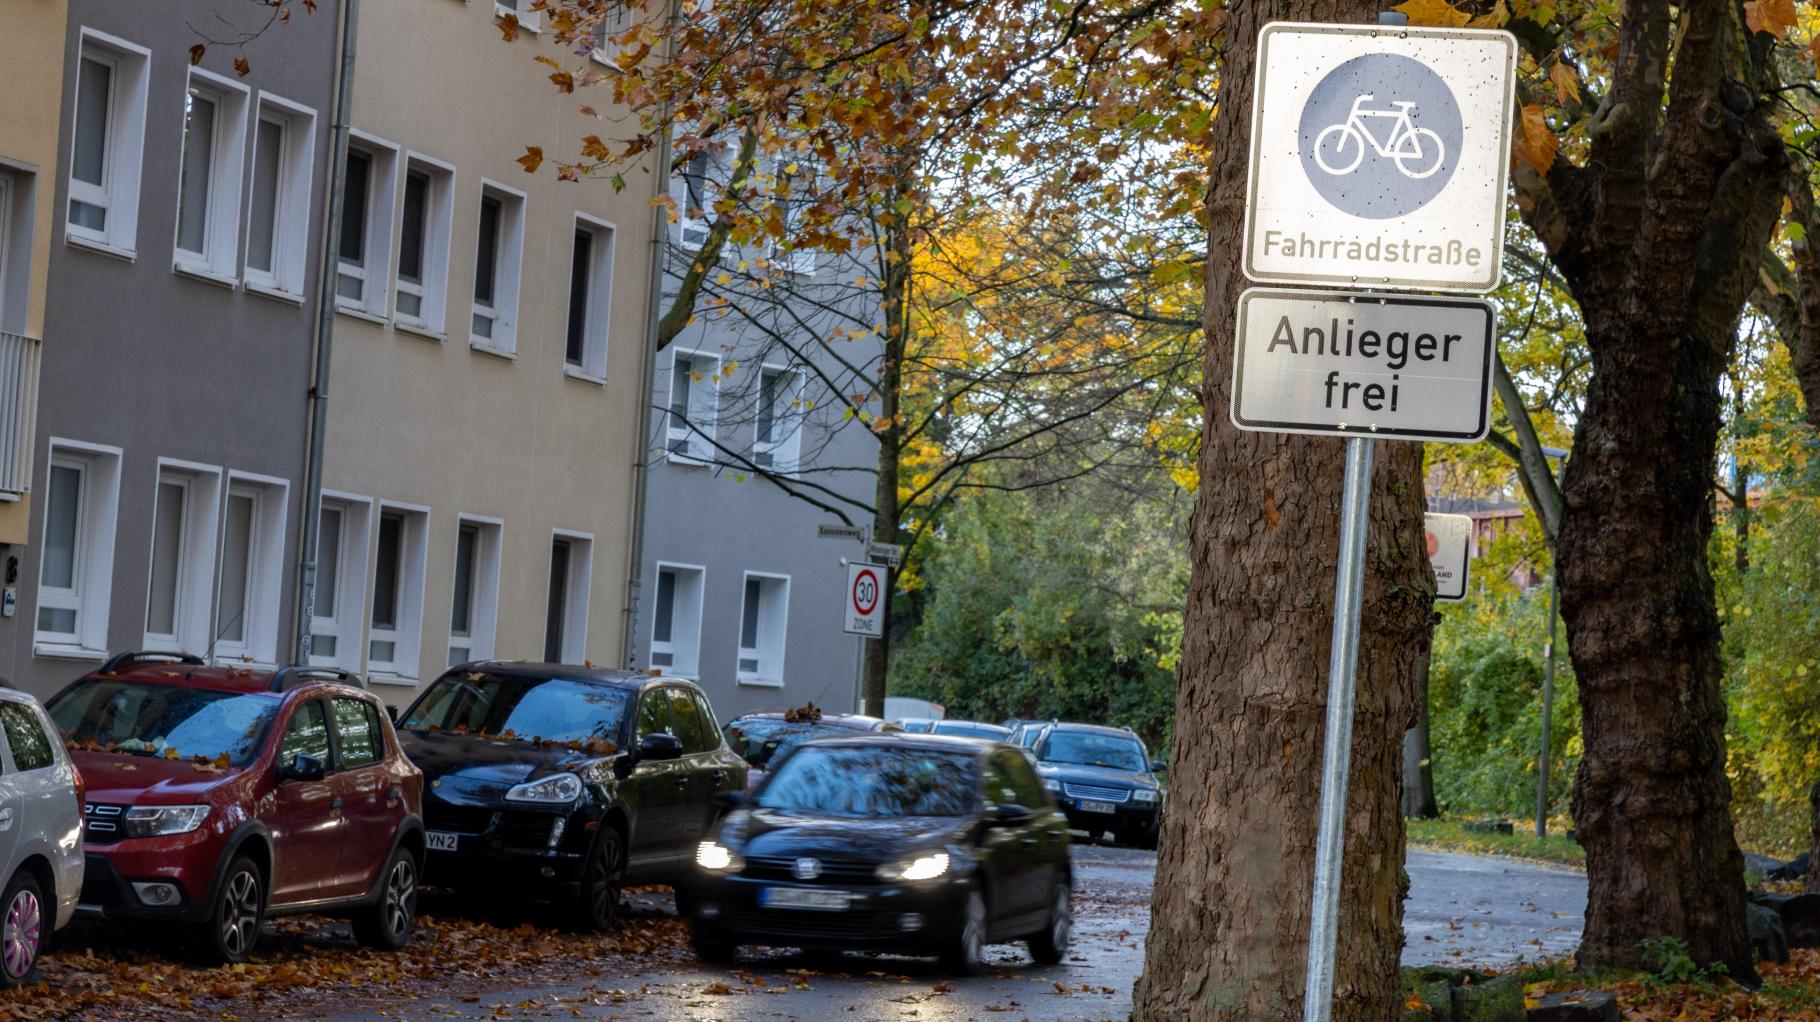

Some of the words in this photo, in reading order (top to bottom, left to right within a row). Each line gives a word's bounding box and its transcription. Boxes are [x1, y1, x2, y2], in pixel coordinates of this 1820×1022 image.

[1263, 230, 1481, 267] Fahrradstraße
[1266, 315, 1463, 370] Anlieger
[1324, 371, 1400, 412] frei
[858, 582, 873, 603] 30
[853, 617, 873, 631] ZONE
[447, 836, 456, 849] 2
